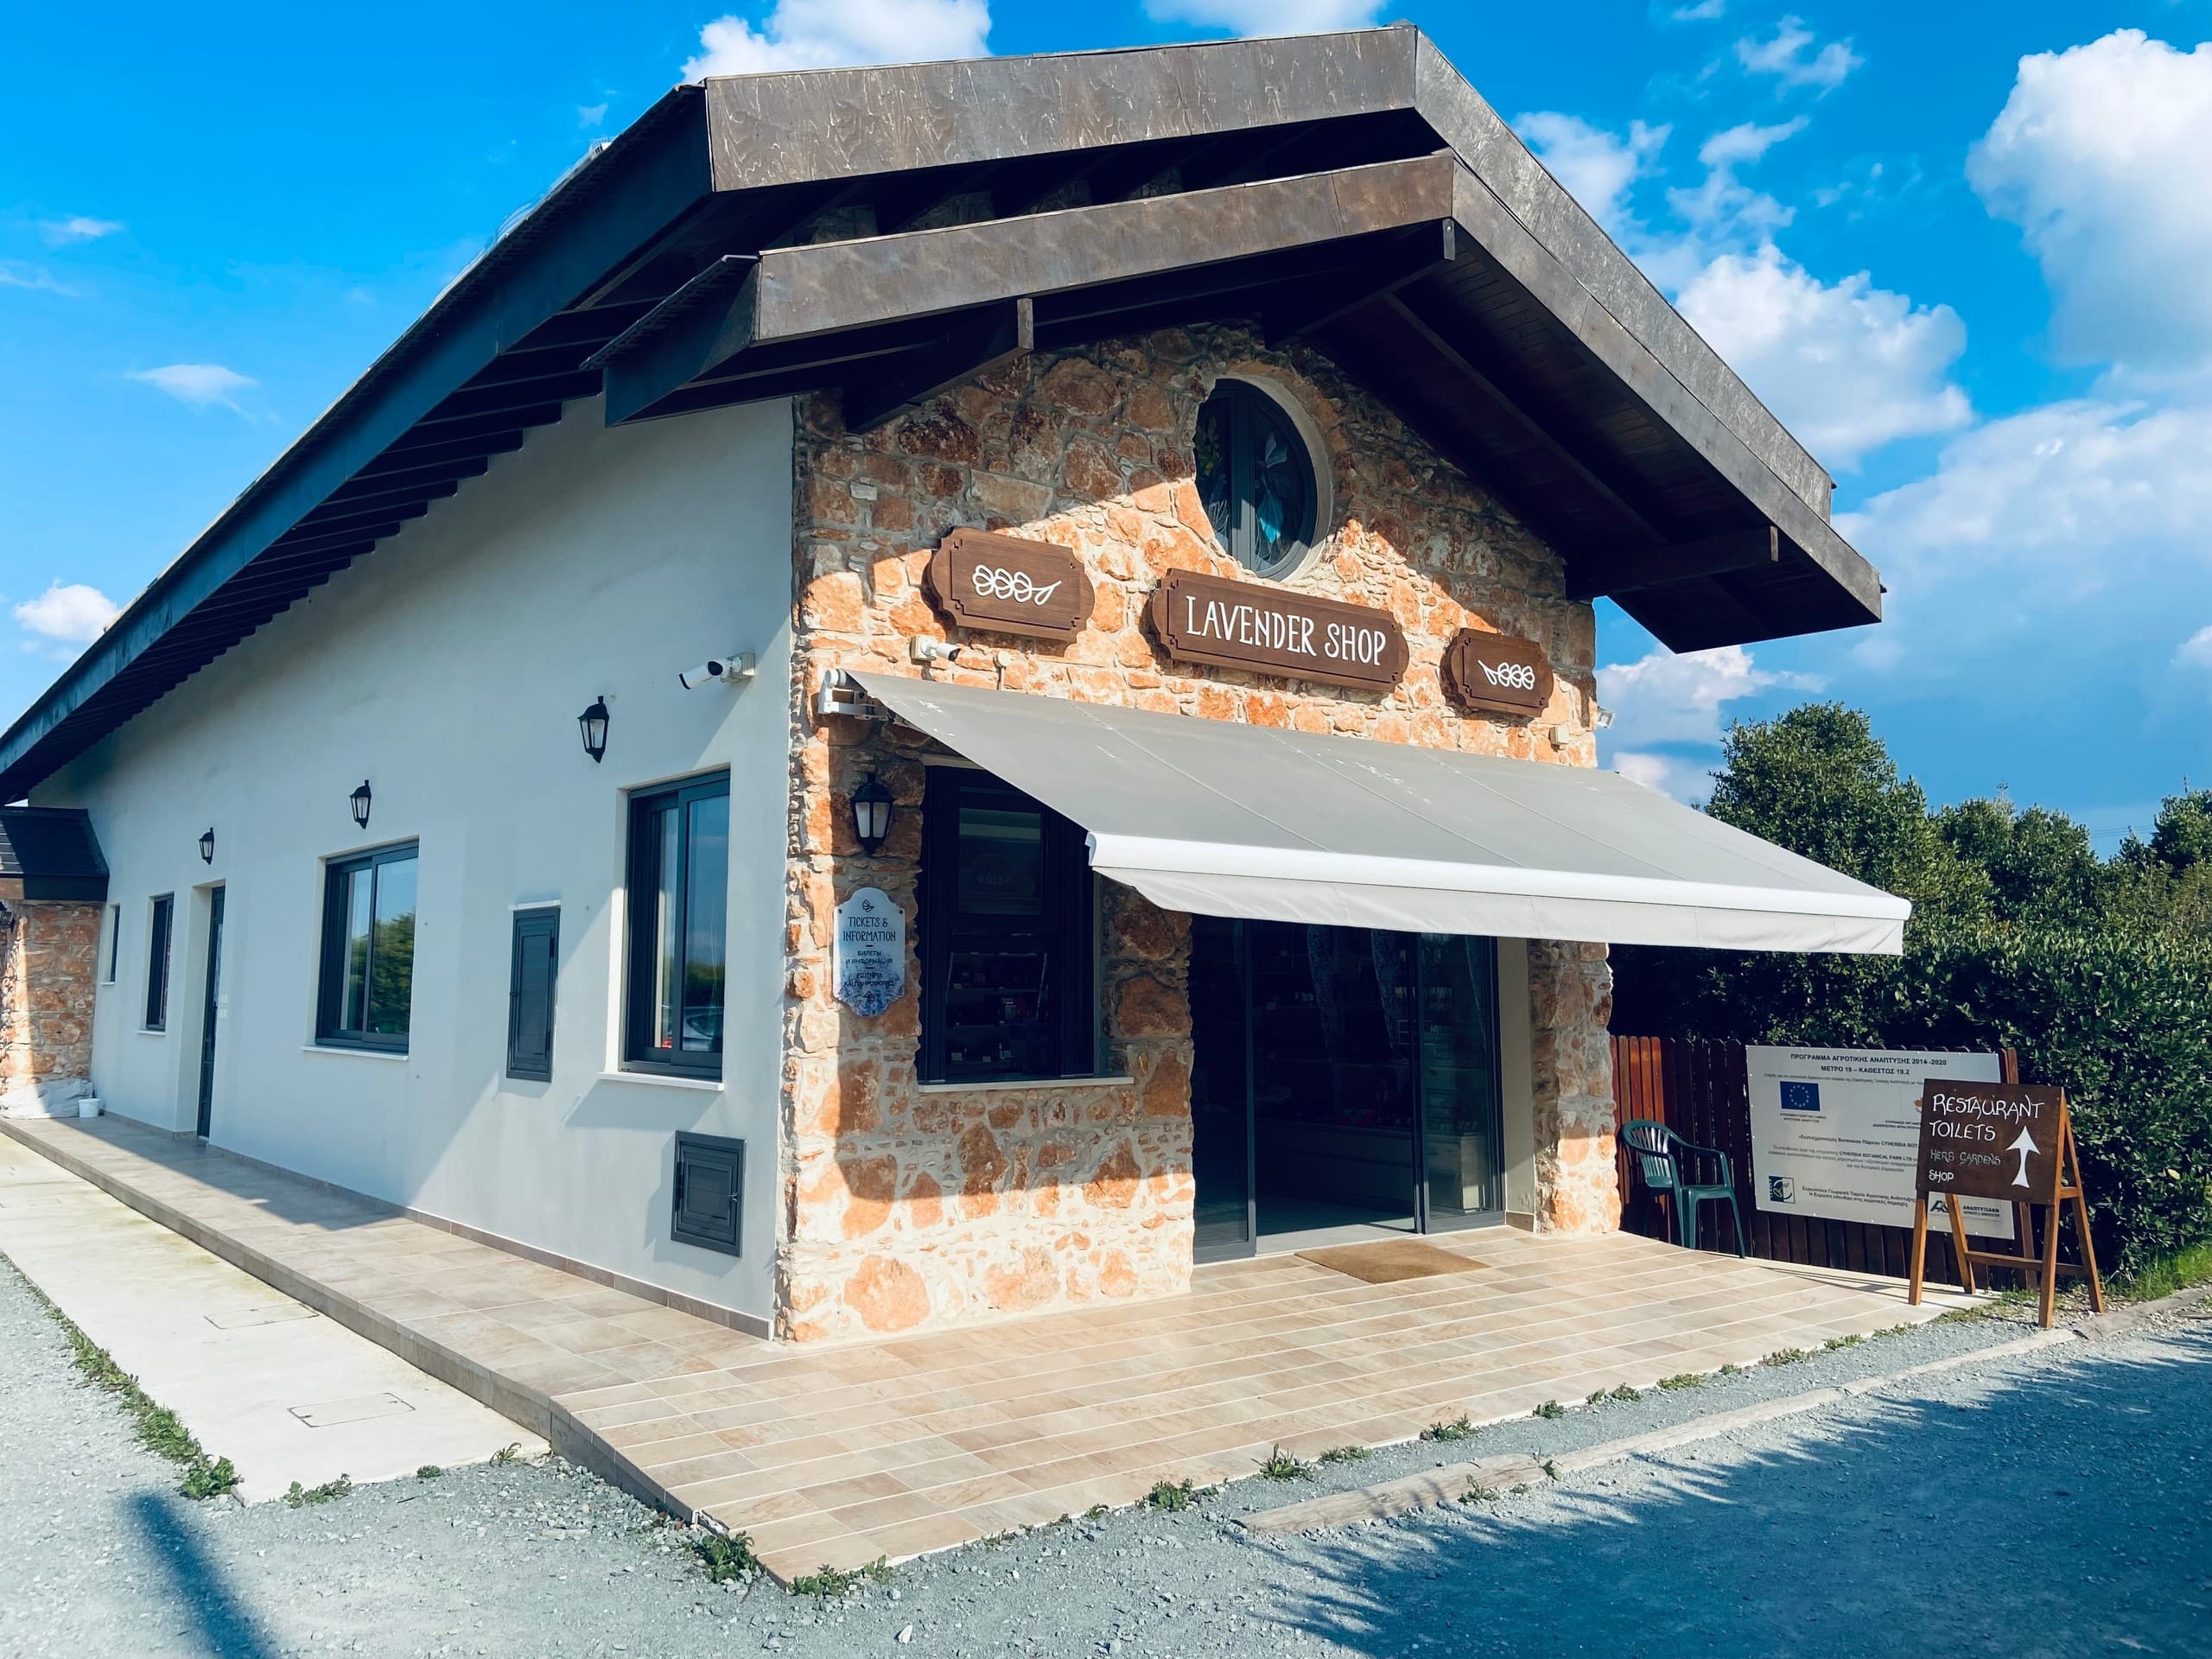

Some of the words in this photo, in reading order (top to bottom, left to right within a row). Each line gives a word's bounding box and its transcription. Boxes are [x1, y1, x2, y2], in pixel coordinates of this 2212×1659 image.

[1185, 595, 1318, 657] LAVENDER
[1324, 622, 1387, 667] SHOP
[848, 917, 880, 927] TICKETS
[882, 918, 888, 928] &
[843, 931, 896, 942] INFORMATION
[1932, 1094, 2044, 1124] RESTAURANT
[1929, 1120, 1996, 1141] TOILETS
[1929, 1149, 1954, 1163] HERB
[1959, 1152, 2001, 1166] GARDENS
[1929, 1169, 1955, 1184] SHOP
